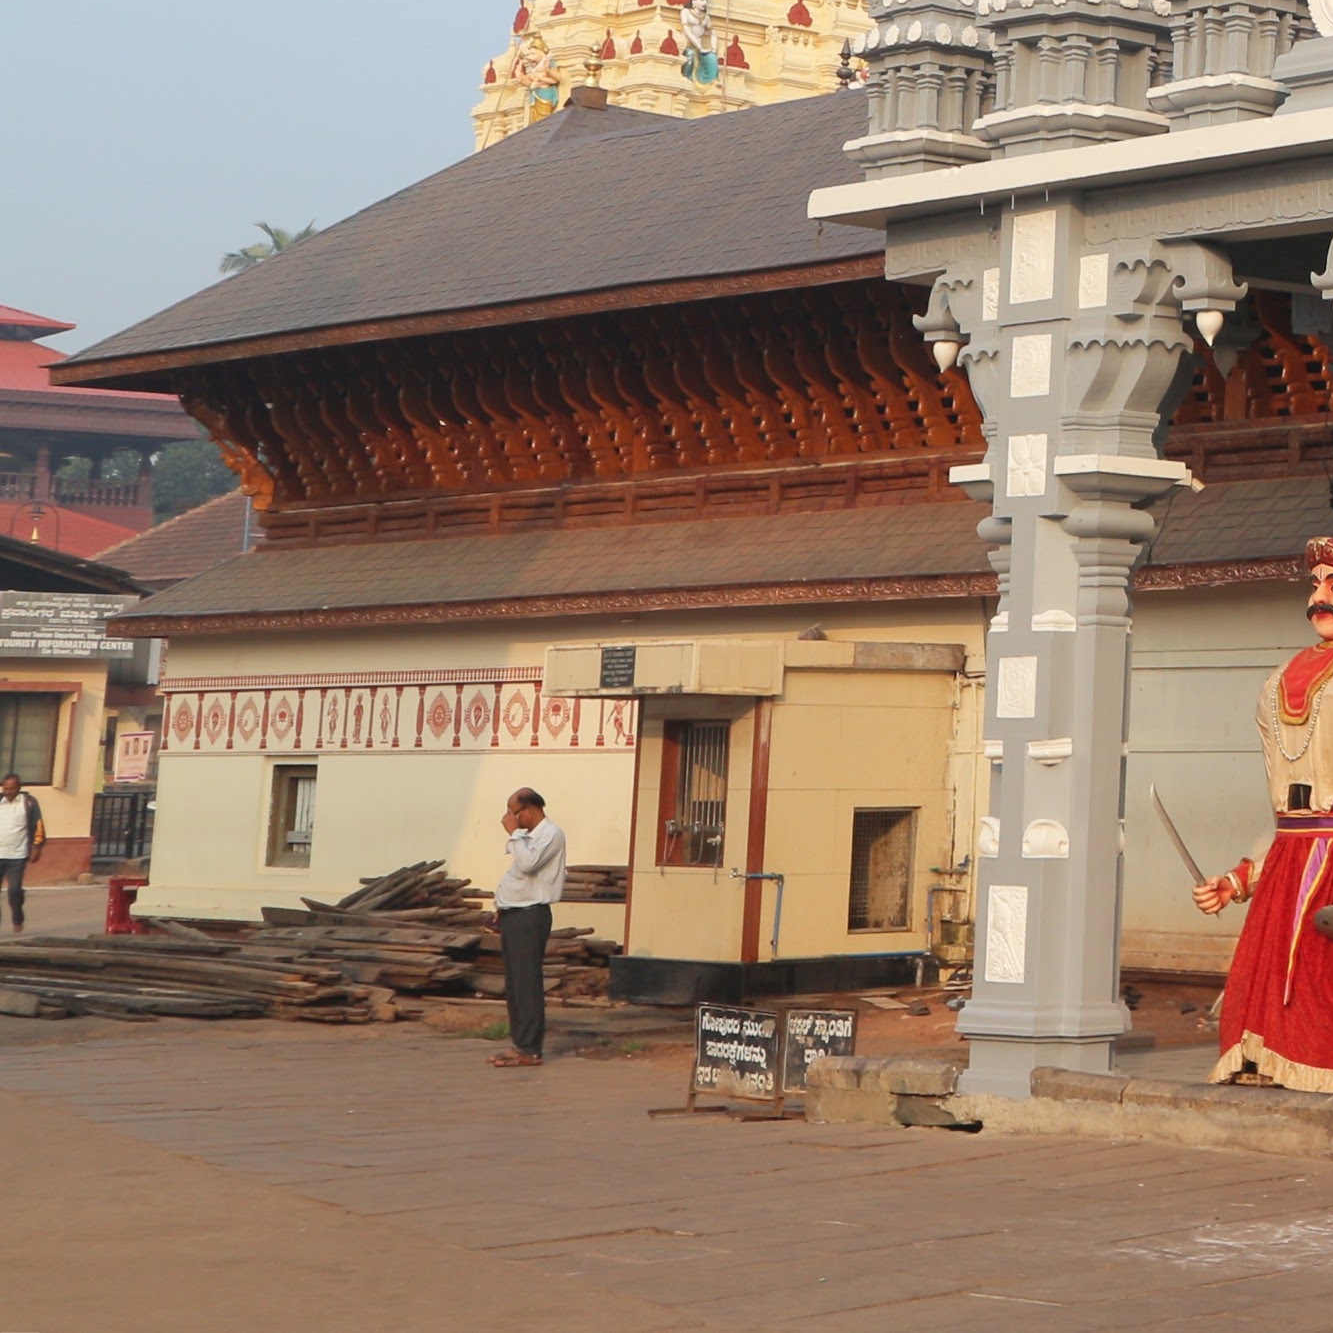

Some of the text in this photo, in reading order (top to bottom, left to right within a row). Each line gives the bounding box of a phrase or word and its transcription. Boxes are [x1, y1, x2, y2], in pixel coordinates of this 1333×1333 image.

[0, 638, 134, 650] TOURIST INFORMATION CENTER
